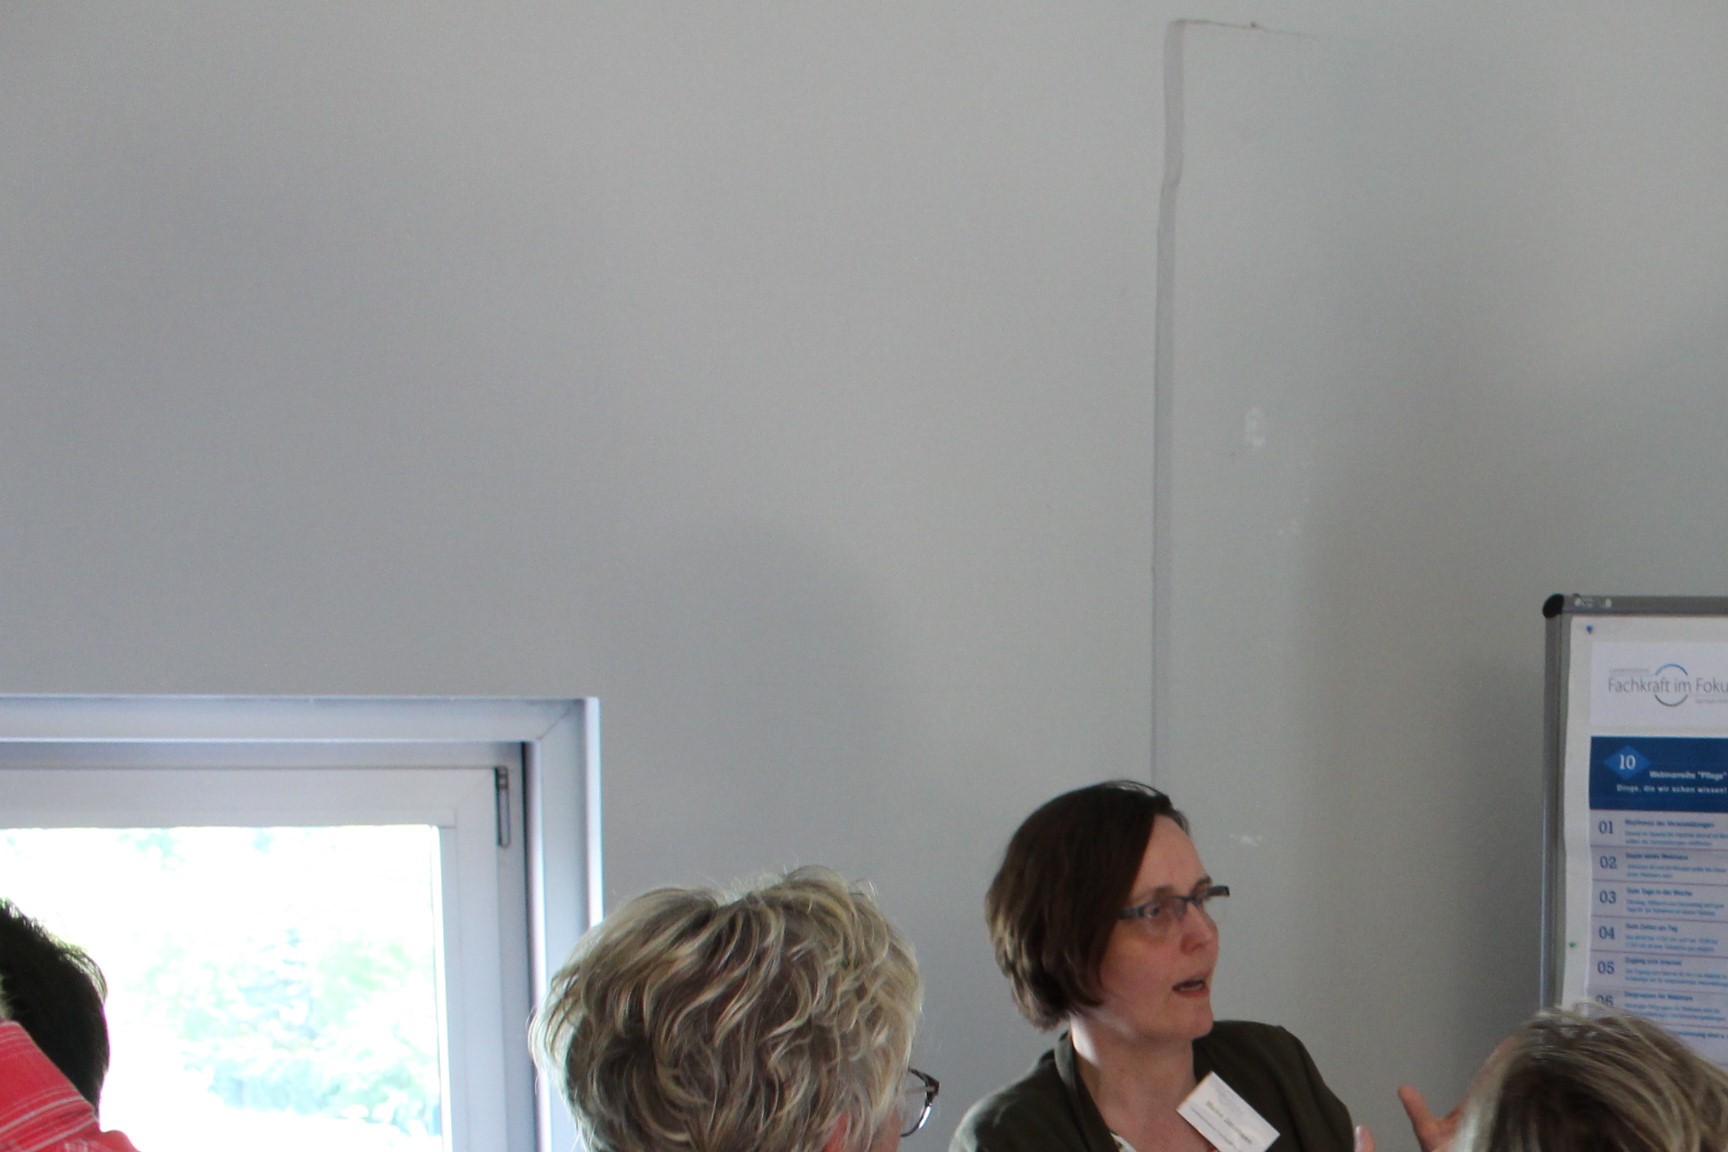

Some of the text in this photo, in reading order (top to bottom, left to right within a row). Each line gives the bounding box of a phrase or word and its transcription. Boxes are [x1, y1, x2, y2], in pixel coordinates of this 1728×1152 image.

[1608, 677, 1670, 693] Fachkraft
[1674, 678, 1691, 693] im
[1618, 754, 1637, 770] 10
[1598, 820, 1614, 835] 01
[1600, 856, 1617, 869] 02
[1600, 890, 1617, 904] 03
[1598, 926, 1616, 940] 04
[1597, 961, 1616, 975] 05
